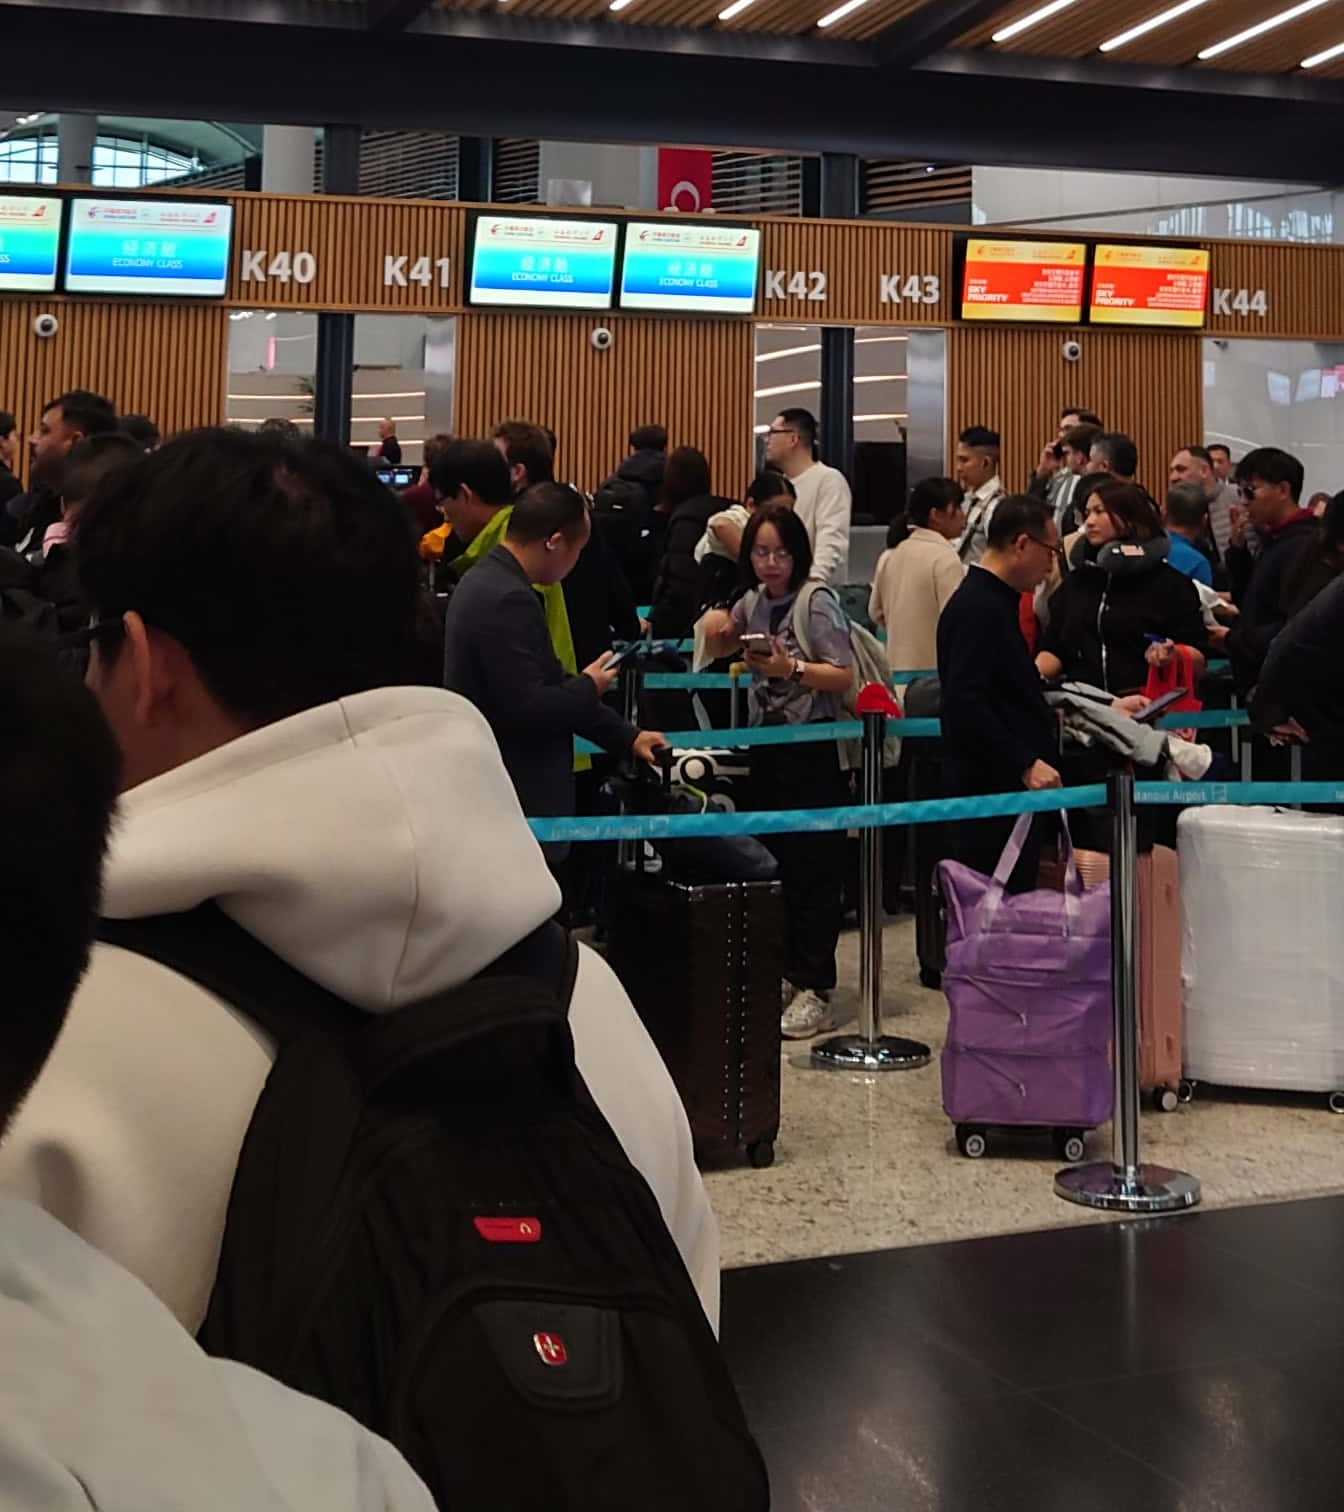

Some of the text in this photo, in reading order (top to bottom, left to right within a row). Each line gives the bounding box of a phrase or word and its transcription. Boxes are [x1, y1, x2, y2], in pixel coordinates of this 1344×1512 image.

[241, 249, 317, 285] K40
[383, 254, 451, 288] K41
[764, 270, 828, 301] K42
[880, 274, 941, 304] K43
[1213, 288, 1268, 317] K44
[1172, 789, 1207, 803] Airport
